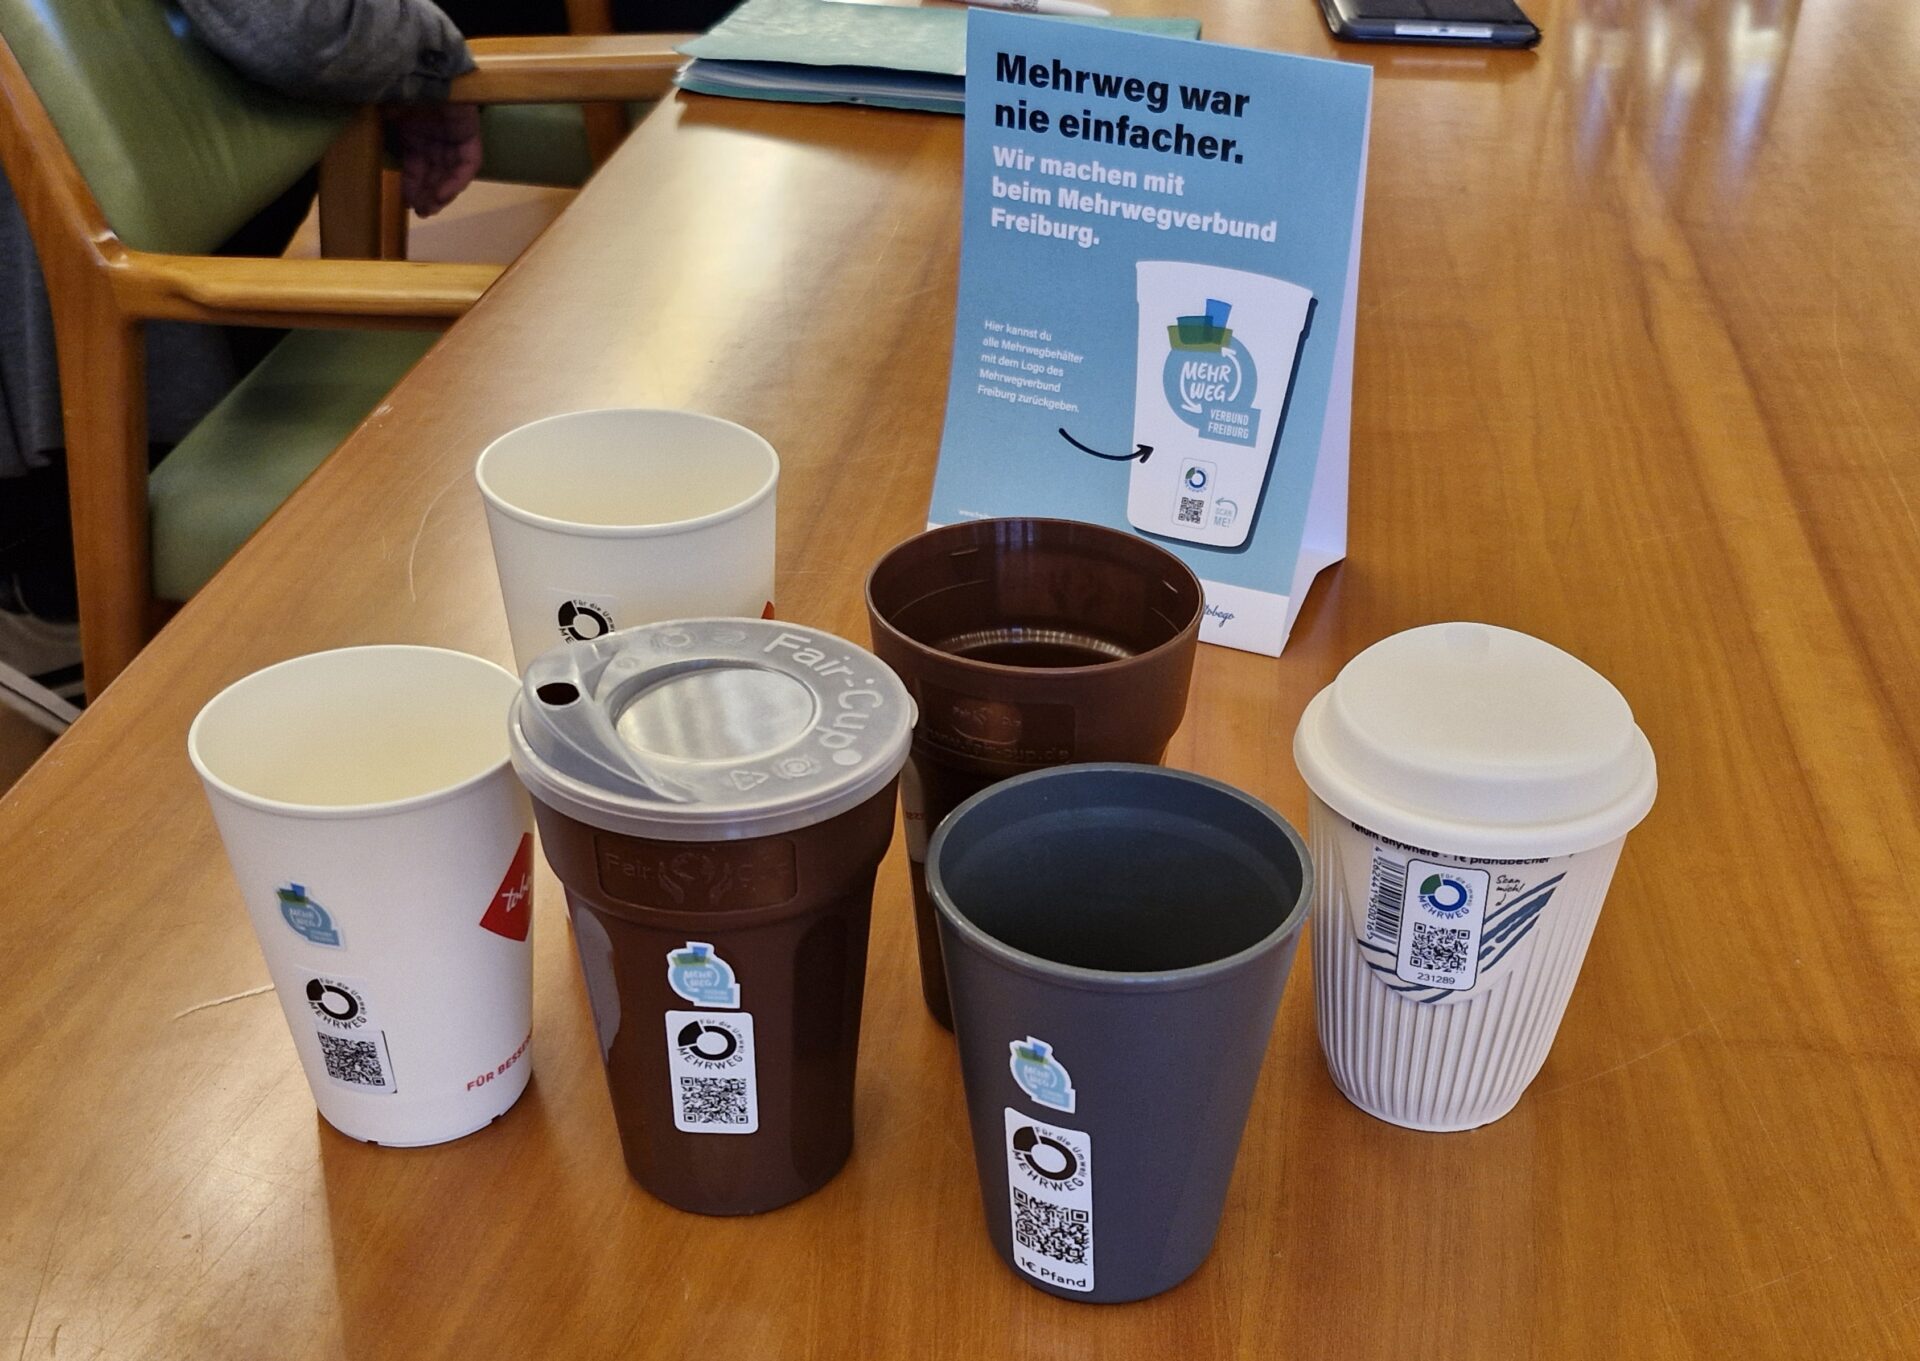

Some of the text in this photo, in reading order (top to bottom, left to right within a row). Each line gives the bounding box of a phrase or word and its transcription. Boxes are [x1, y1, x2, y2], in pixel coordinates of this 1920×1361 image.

[996, 52, 1250, 117] Mehrweg war
[995, 100, 1243, 164] nie einfacher.
[993, 146, 1185, 196] Wir machen mit
[992, 177, 1277, 242] beim Mehrwegverbund
[991, 207, 1100, 248] Freiburg.
[984, 320, 1052, 341] Hier kannst du
[982, 337, 1084, 364] alle Mehrwegbehälter
[981, 354, 1064, 377] mit dem Logo des
[1184, 361, 1231, 383] MEHR
[979, 369, 1061, 393] Mehrwegverbund
[1189, 381, 1226, 402] WEG
[977, 384, 1079, 413] Freiburg zurückgeben.
[1210, 409, 1249, 426] VERBUND
[1207, 422, 1249, 439] FREIBURG
[1417, 895, 1470, 919] MEHRWEG
[1417, 972, 1456, 985] 231289
[308, 1001, 367, 1029] MEHRWEG
[676, 1047, 743, 1070] MEHRWEG
[467, 1072, 495, 1091] FÜR
[1012, 1149, 1084, 1192] MEHRWEG
[1020, 1256, 1037, 1273] 1€
